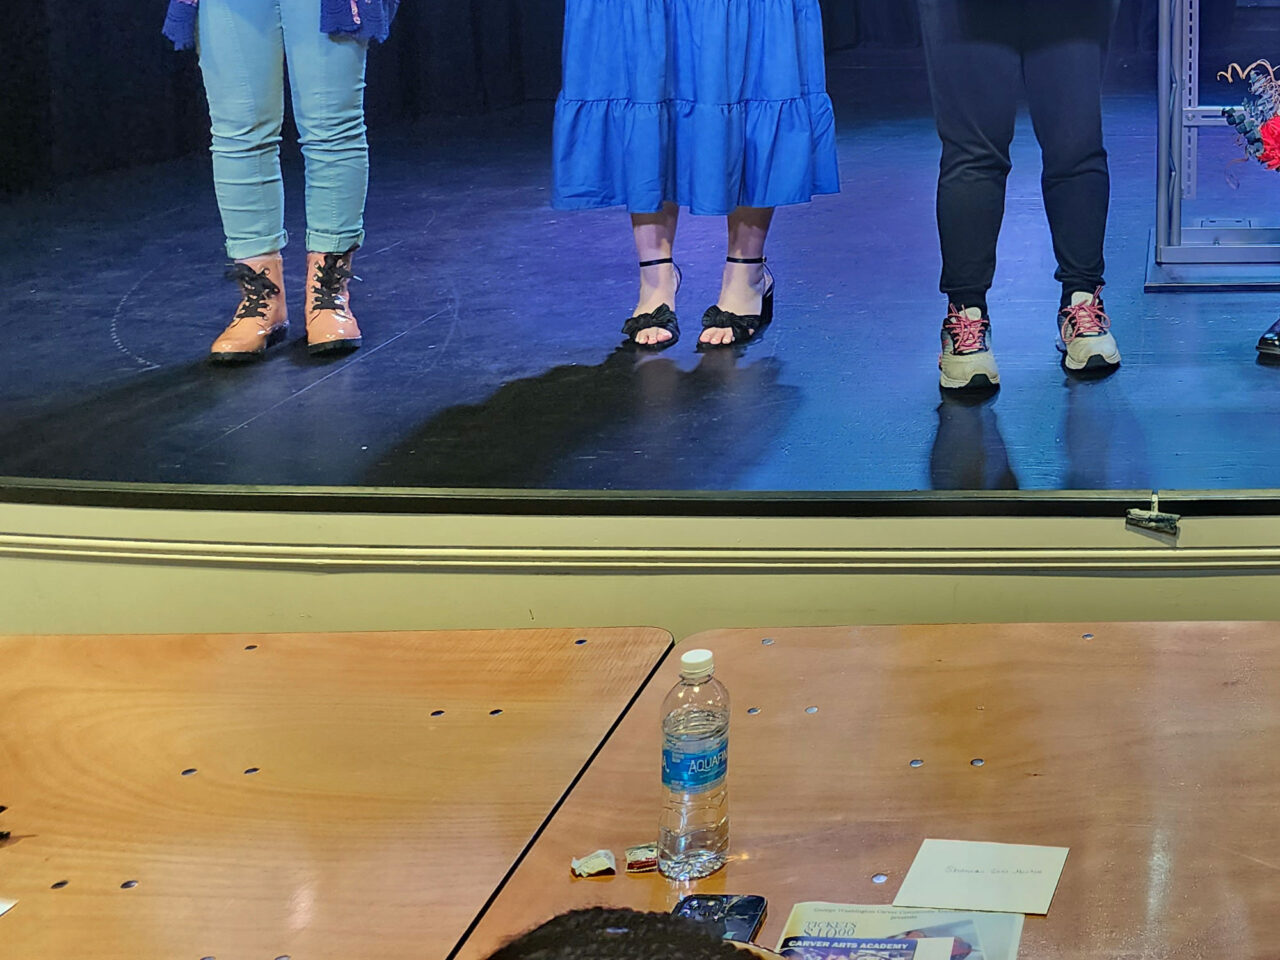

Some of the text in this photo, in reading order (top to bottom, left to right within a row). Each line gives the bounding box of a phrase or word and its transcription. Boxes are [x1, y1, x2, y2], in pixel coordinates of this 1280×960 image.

[688, 750, 728, 776] AQUAFIN
[806, 920, 857, 929] TICKETS
[788, 939, 830, 948] CARVER
